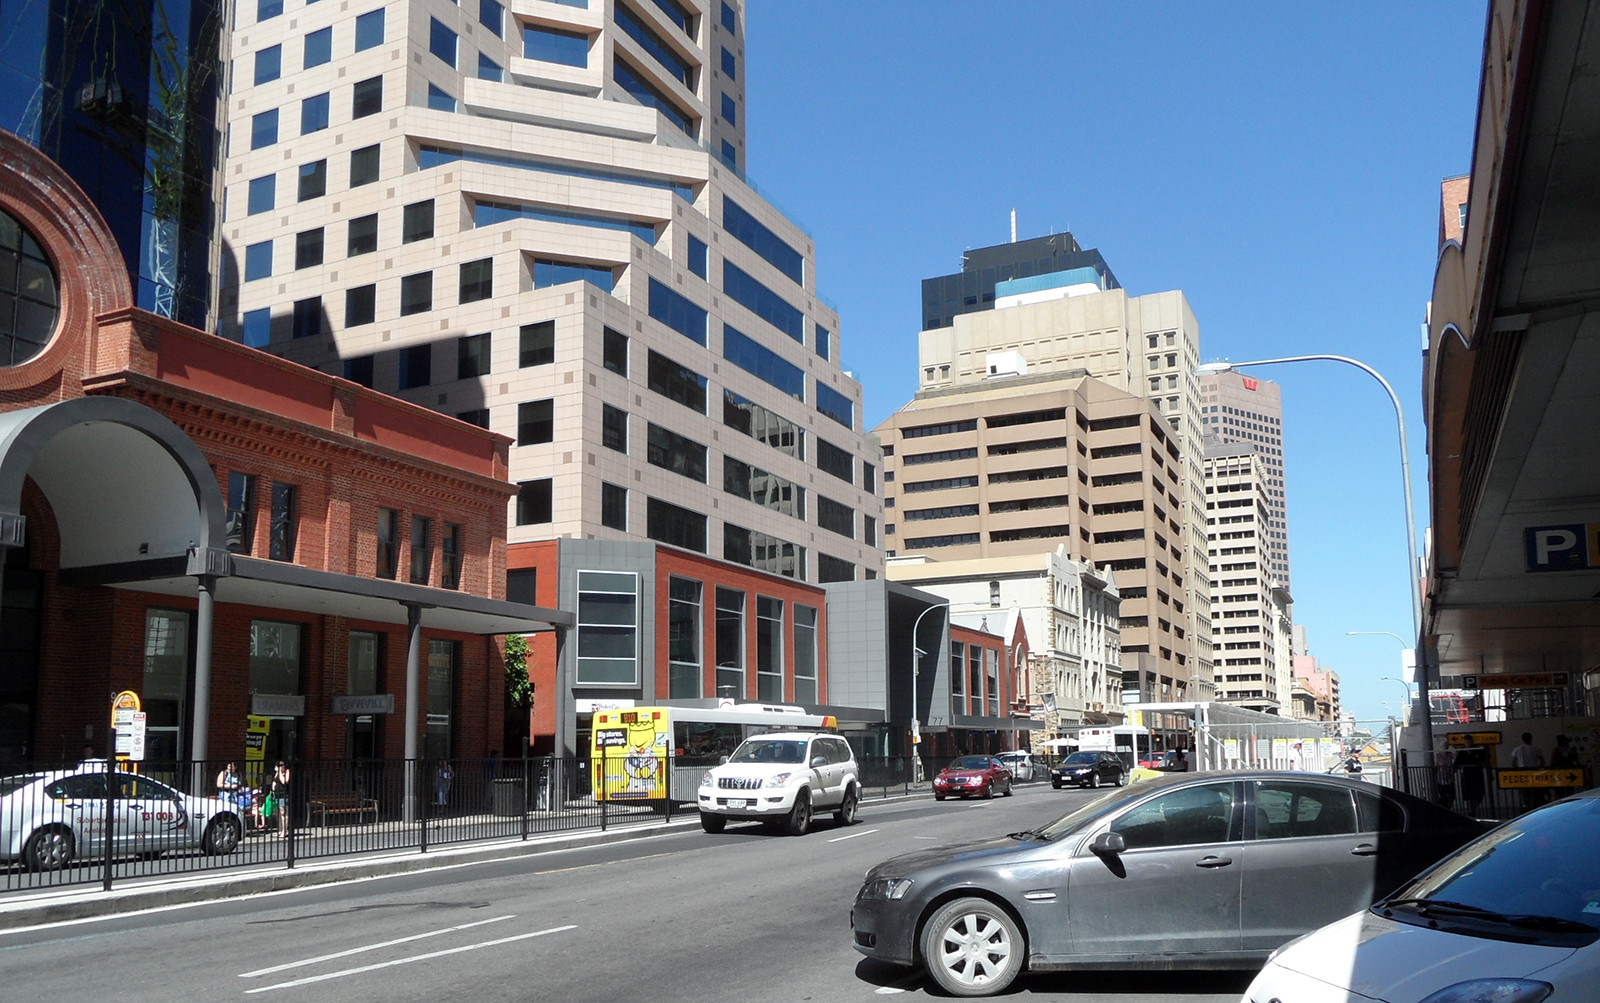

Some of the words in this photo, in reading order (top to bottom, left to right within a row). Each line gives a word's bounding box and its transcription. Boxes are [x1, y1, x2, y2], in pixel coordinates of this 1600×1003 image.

[1535, 529, 1577, 565] P
[1465, 678, 1475, 688] P
[1481, 676, 1508, 686] Public
[1511, 675, 1528, 684] Car
[1529, 674, 1549, 683] Park
[932, 717, 943, 725] 77
[597, 731, 605, 739] Big
[1503, 774, 1561, 784] PEDESTRIANS
